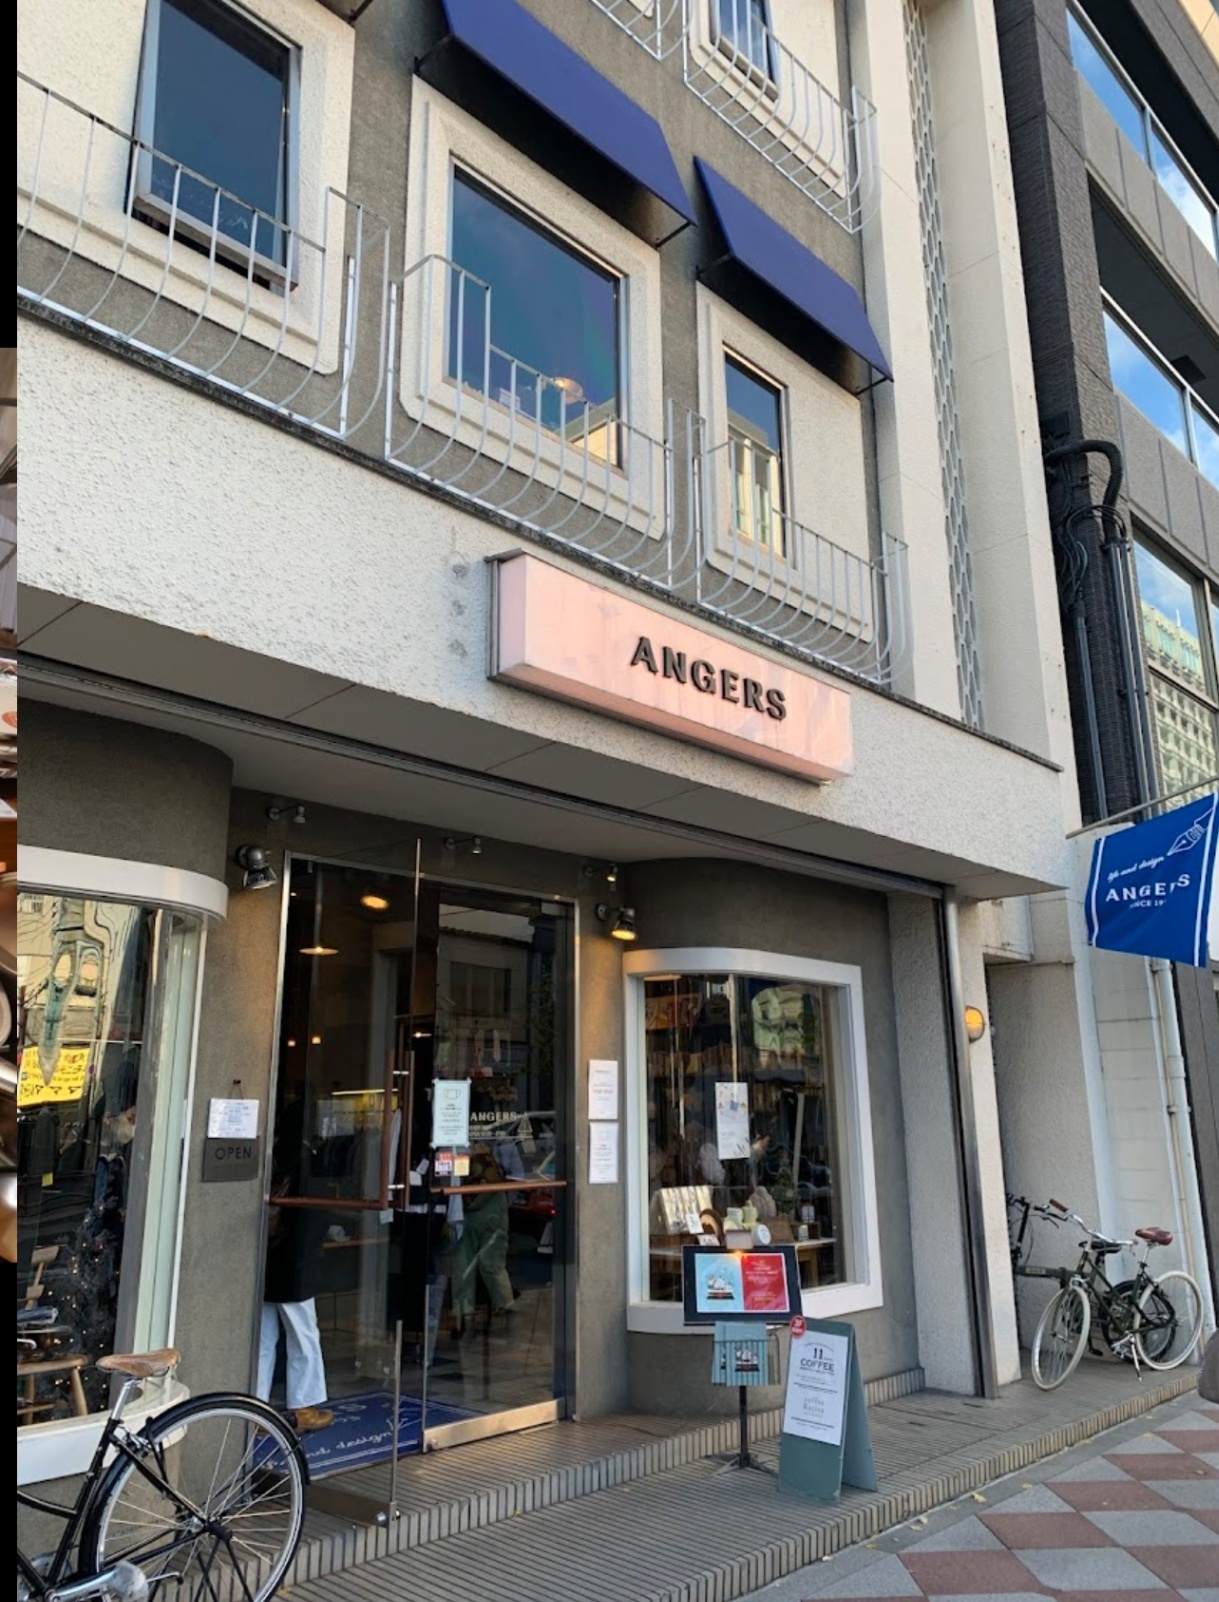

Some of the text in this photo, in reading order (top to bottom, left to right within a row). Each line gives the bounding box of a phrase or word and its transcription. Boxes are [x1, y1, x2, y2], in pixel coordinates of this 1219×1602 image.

[630, 636, 787, 721] ANGERS
[470, 1111, 517, 1121] ANGERS
[215, 1147, 252, 1160] OPEN
[800, 1358, 835, 1373] COFFEE
